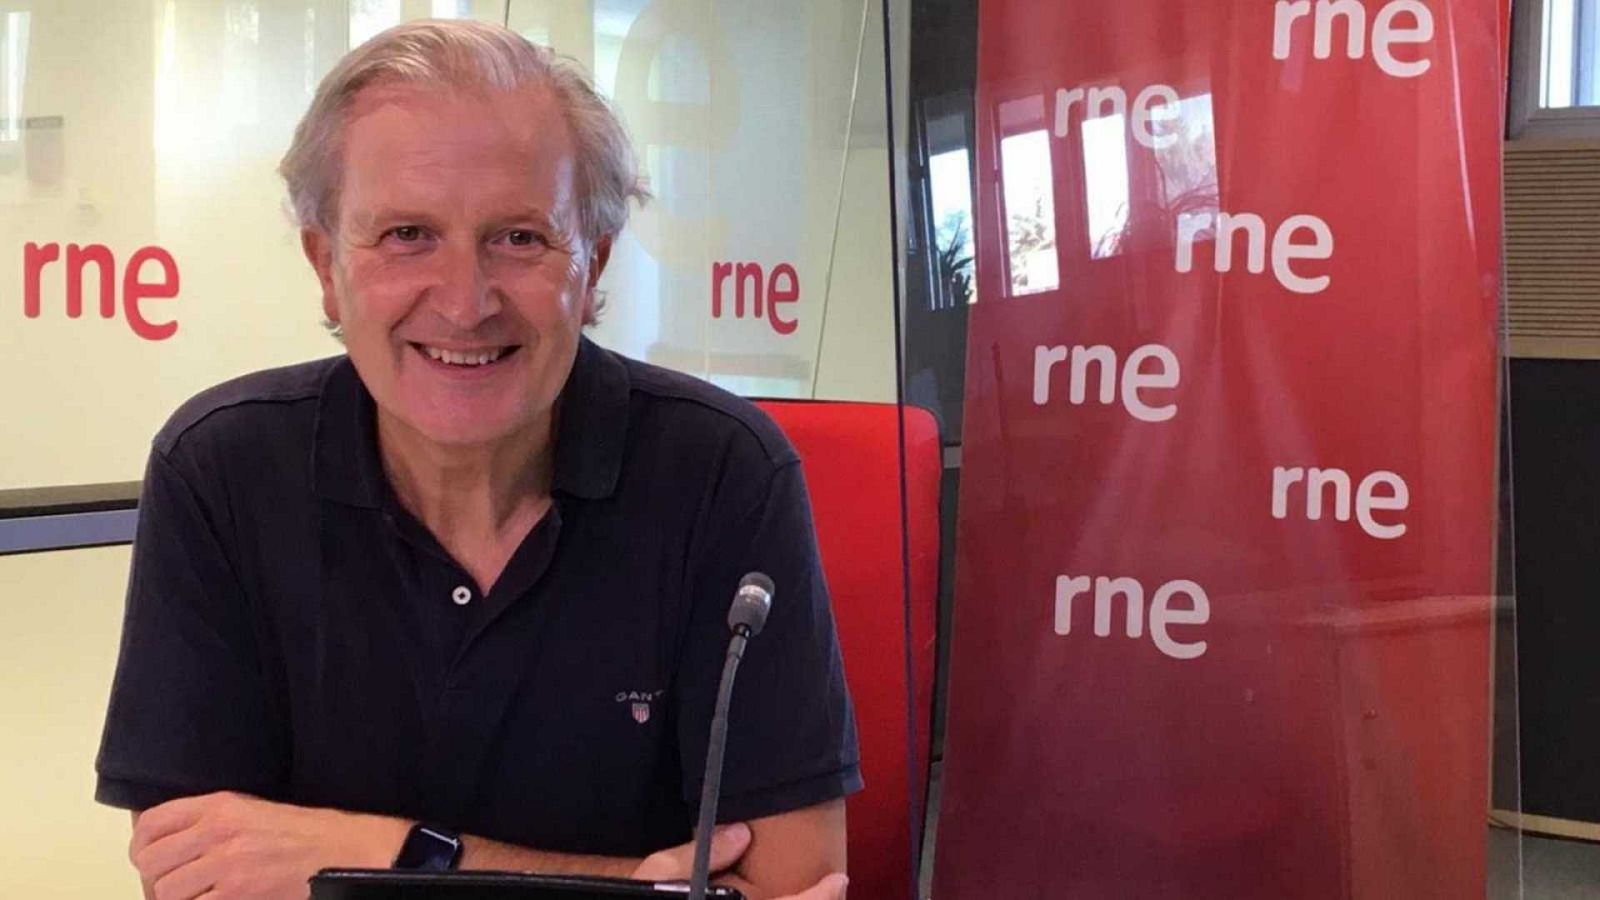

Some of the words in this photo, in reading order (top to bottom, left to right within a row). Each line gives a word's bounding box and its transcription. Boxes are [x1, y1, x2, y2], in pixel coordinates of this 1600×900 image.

[1273, 0, 1434, 78] rne
[1055, 84, 1181, 149] rne
[24, 242, 180, 341] rne
[1175, 211, 1334, 294] rne
[711, 262, 800, 335] rne
[1034, 344, 1180, 422] rne
[1272, 466, 1409, 539] rne
[1055, 575, 1210, 659] rne
